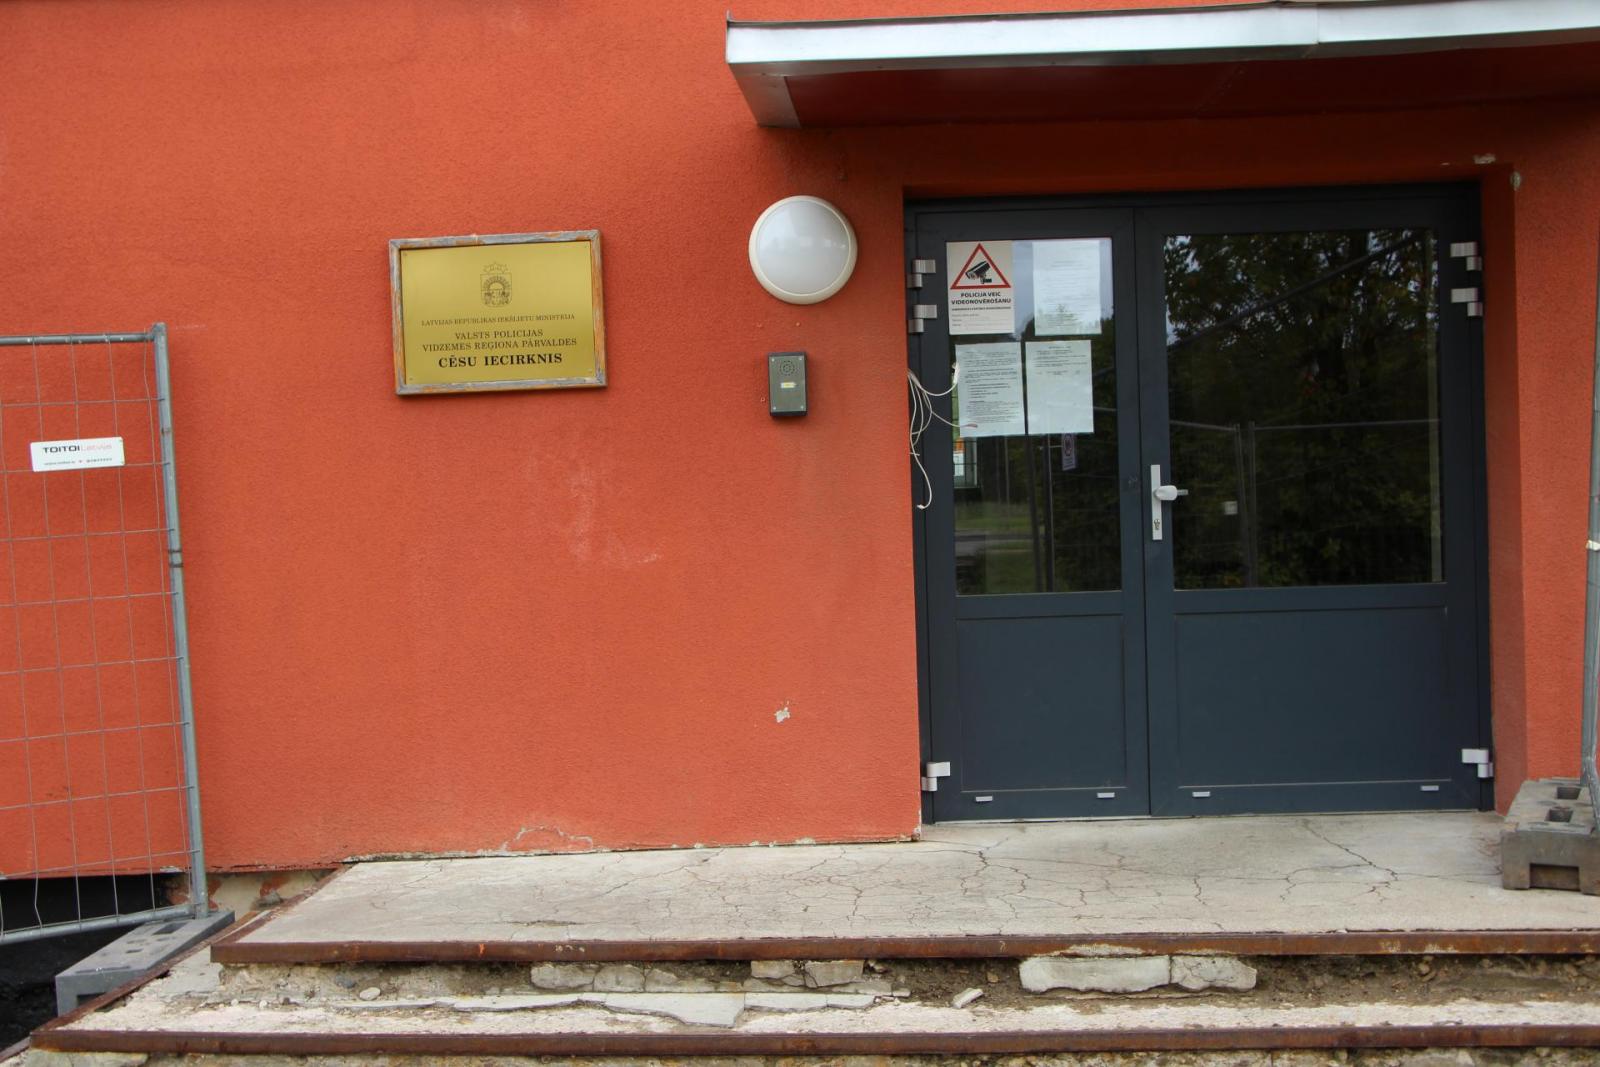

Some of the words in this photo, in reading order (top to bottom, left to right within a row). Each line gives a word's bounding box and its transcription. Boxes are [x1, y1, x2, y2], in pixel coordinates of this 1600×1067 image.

[455, 331, 490, 340] VALSTS
[494, 329, 544, 339] POLICIJAS
[422, 342, 472, 352] VIDZEMES
[438, 354, 477, 368] CĒSU
[484, 352, 563, 366] IECIRKNIS
